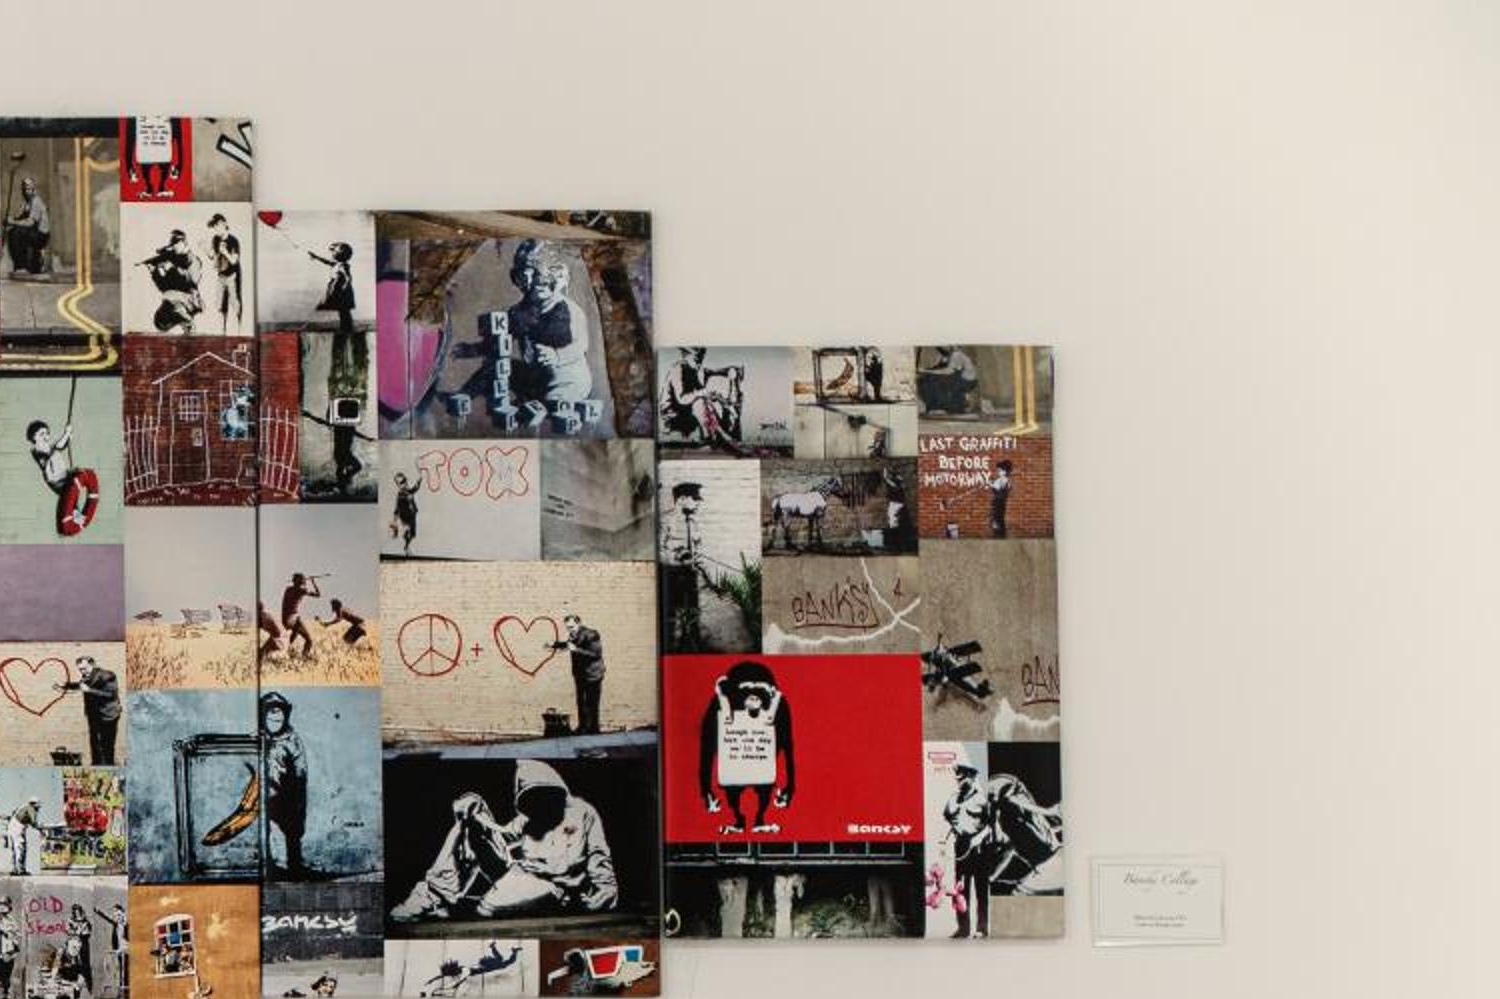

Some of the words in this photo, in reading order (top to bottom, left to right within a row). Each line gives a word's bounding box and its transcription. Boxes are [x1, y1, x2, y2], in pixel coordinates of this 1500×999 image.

[920, 437, 954, 453] LAST
[959, 436, 1018, 452] GRAFFITI
[939, 455, 991, 470] BEFORE
